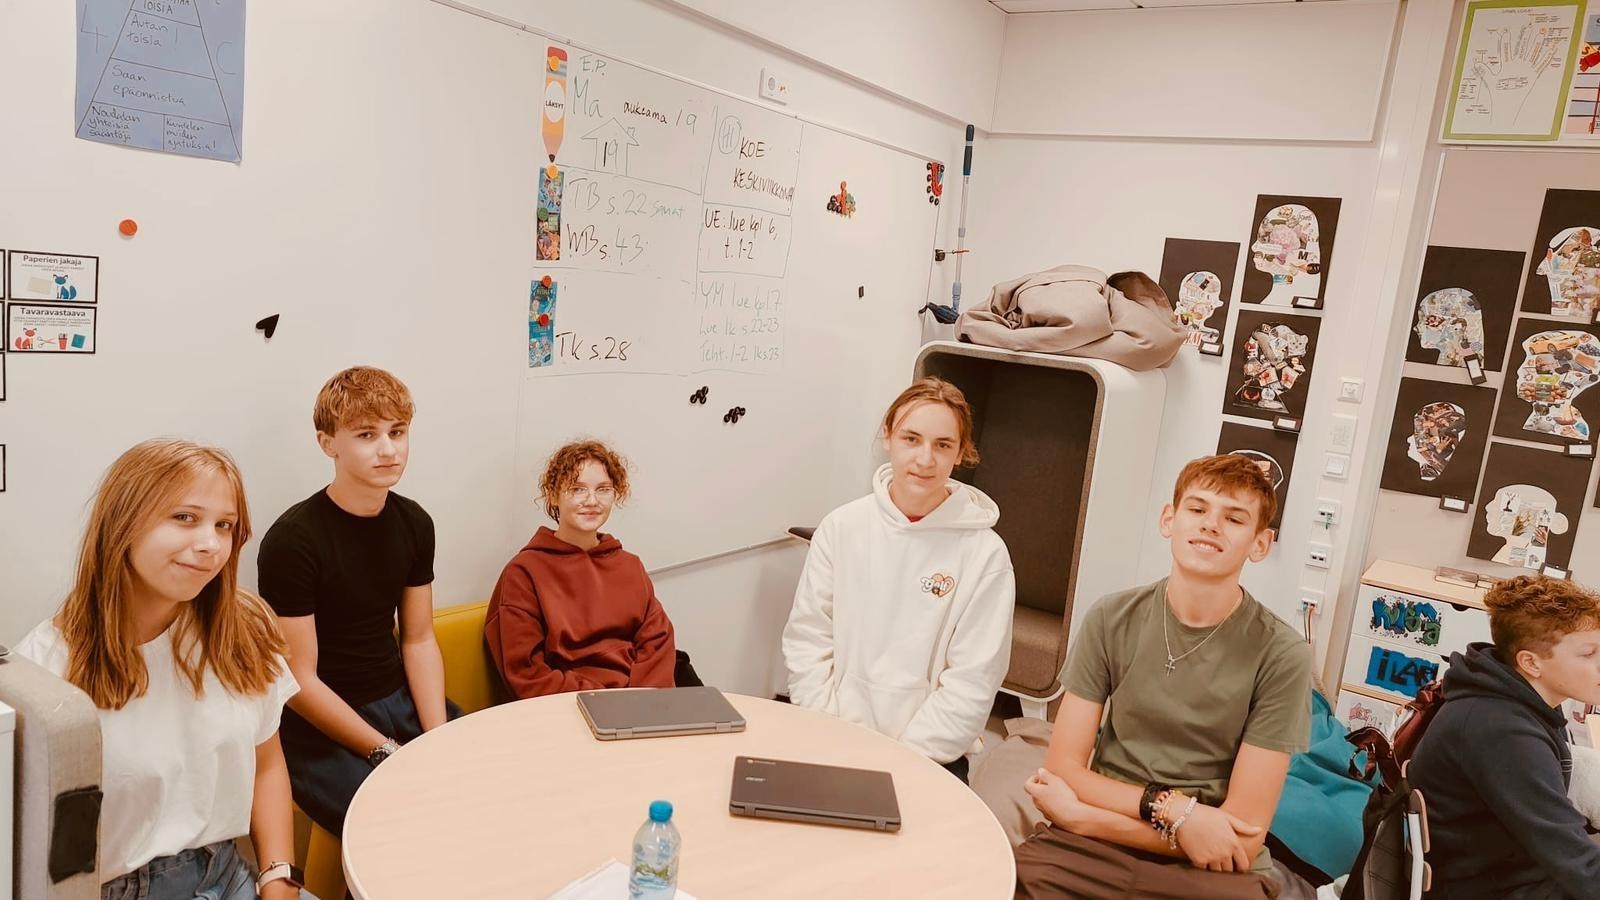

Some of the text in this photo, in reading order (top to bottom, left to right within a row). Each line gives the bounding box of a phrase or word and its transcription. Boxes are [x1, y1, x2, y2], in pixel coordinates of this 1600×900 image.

[130, 13, 169, 32] Autan
[126, 31, 162, 47] toisia
[112, 65, 148, 82] Saan
[572, 76, 603, 118] Ma
[738, 136, 766, 160] KOE
[569, 177, 601, 211] TB
[728, 210, 746, 232] lue
[23, 254, 82, 267] Paperien jakaja
[20, 307, 86, 317] Tavaravastaava
